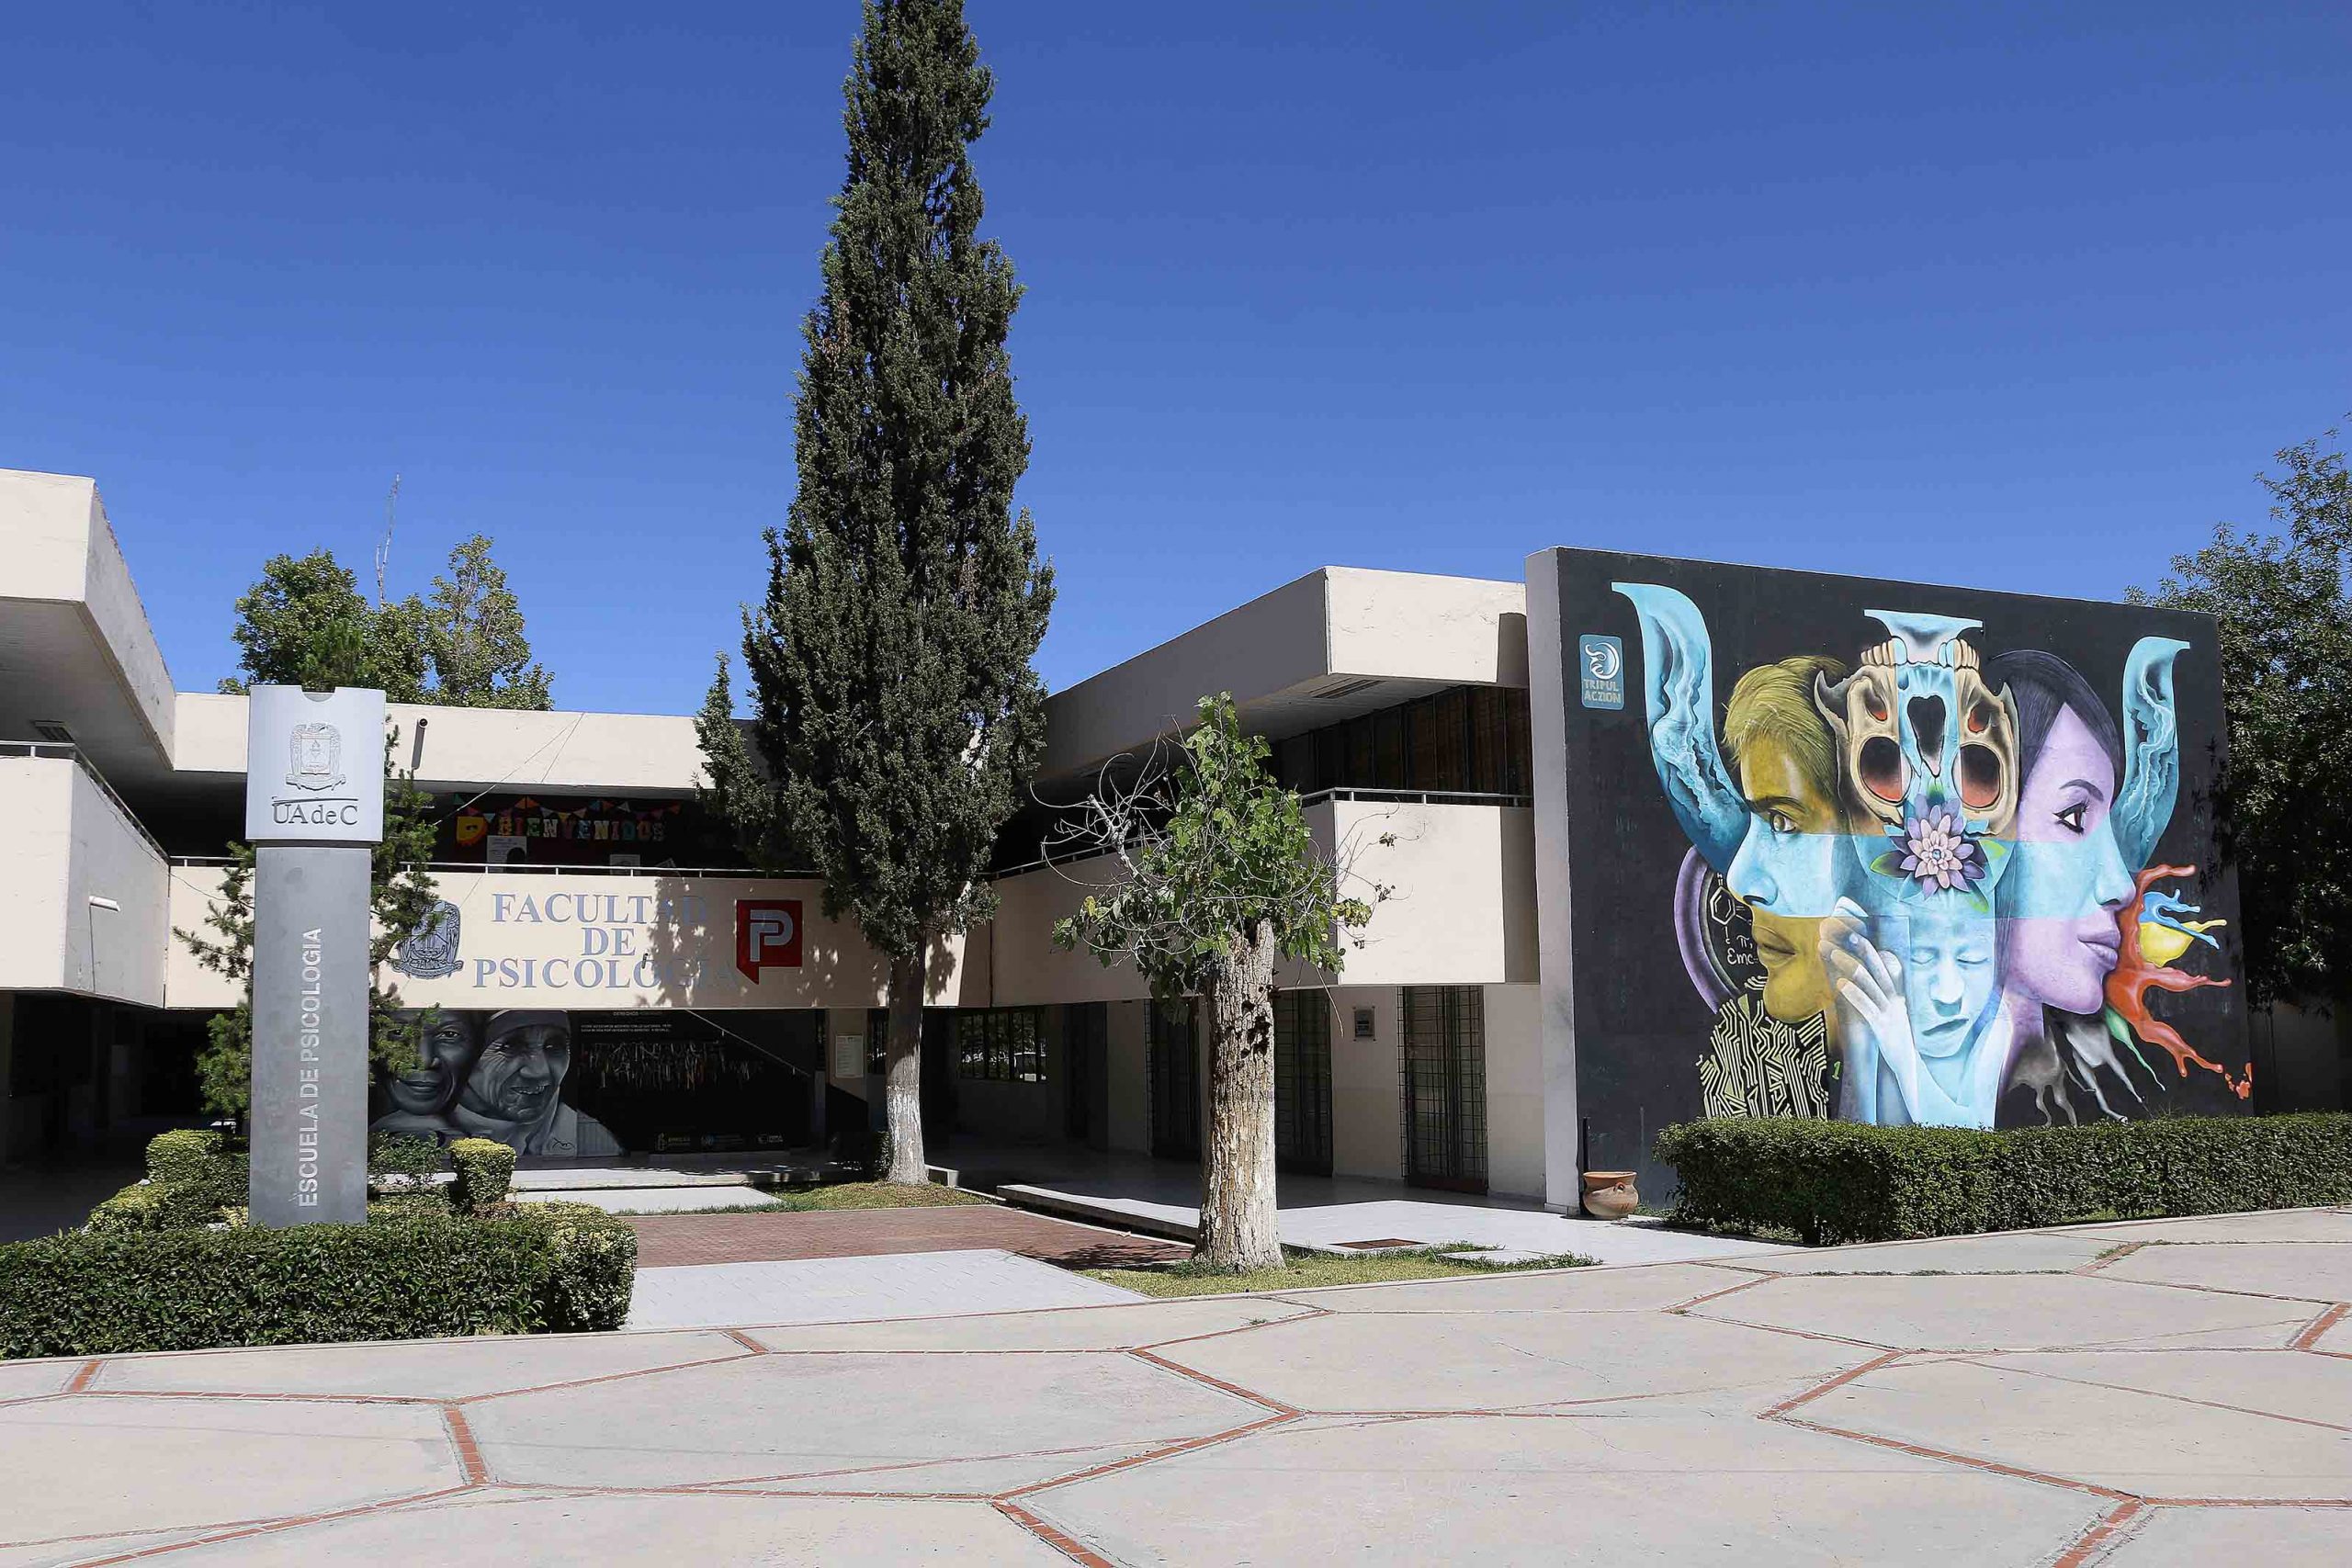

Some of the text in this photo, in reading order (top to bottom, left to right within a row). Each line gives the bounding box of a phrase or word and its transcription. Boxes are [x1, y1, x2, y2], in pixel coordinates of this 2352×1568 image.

[1583, 678, 1620, 692] TRIPUL
[1584, 690, 1621, 703] ACZION
[497, 816, 666, 842] BIENVENIDOS
[492, 893, 707, 925] FACULTAD
[581, 927, 637, 956] DE
[472, 957, 739, 989] PSICOLOGIA
[298, 927, 322, 1208] ESCUELA DE PSICOLOGIA
